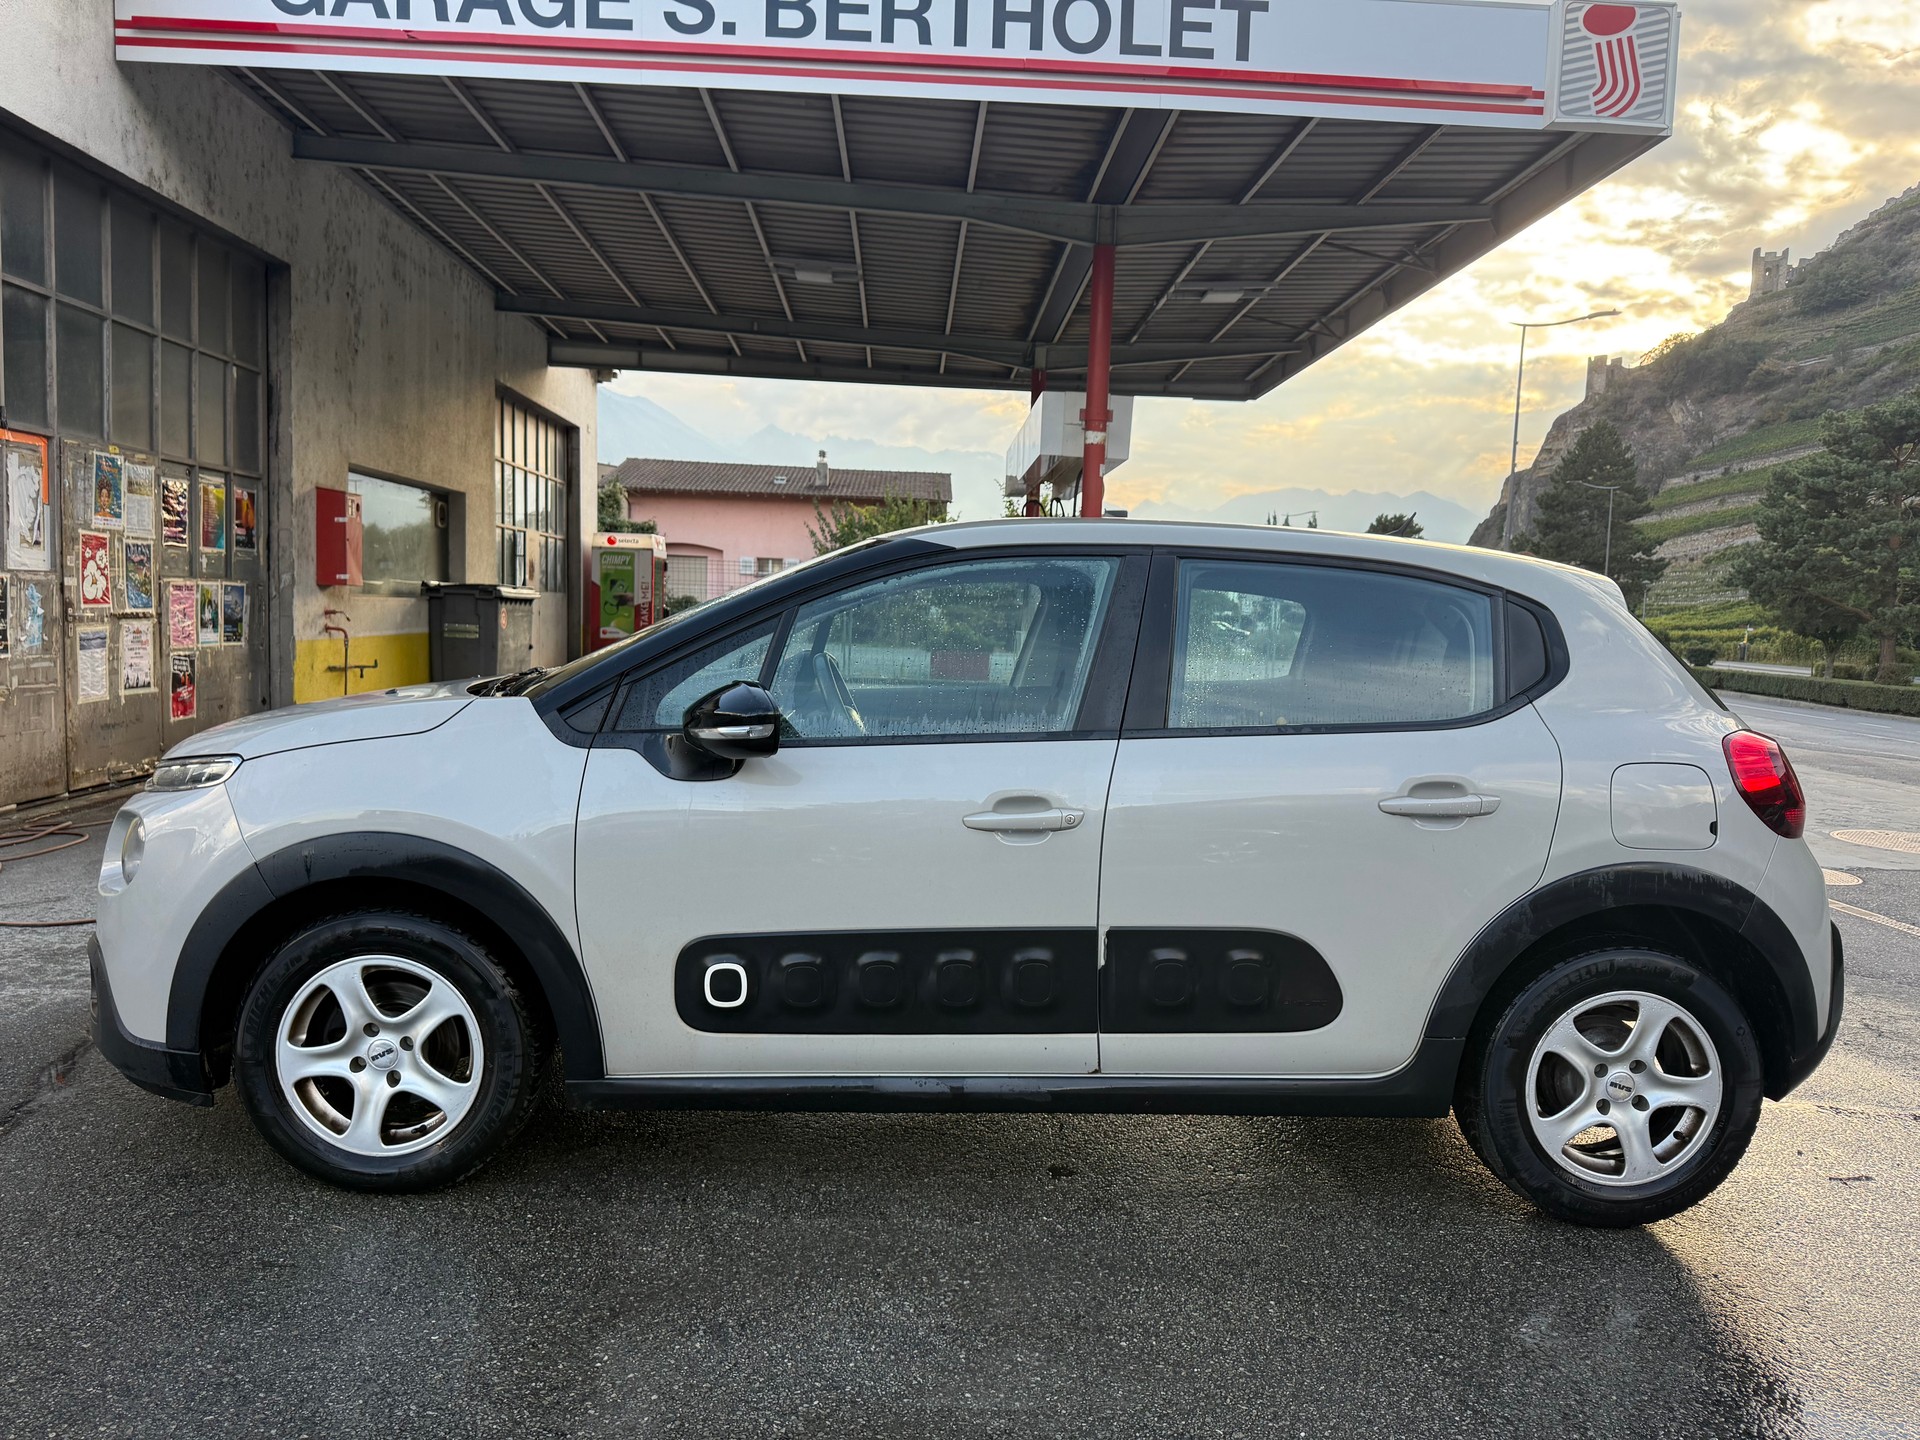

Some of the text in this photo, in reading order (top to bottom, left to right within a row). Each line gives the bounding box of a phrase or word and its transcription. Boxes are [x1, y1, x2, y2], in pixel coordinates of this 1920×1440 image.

[765, 0, 1269, 62] BERTHOLET
[602, 554, 631, 566] CHIMPY
[640, 601, 649, 627] TAKE
